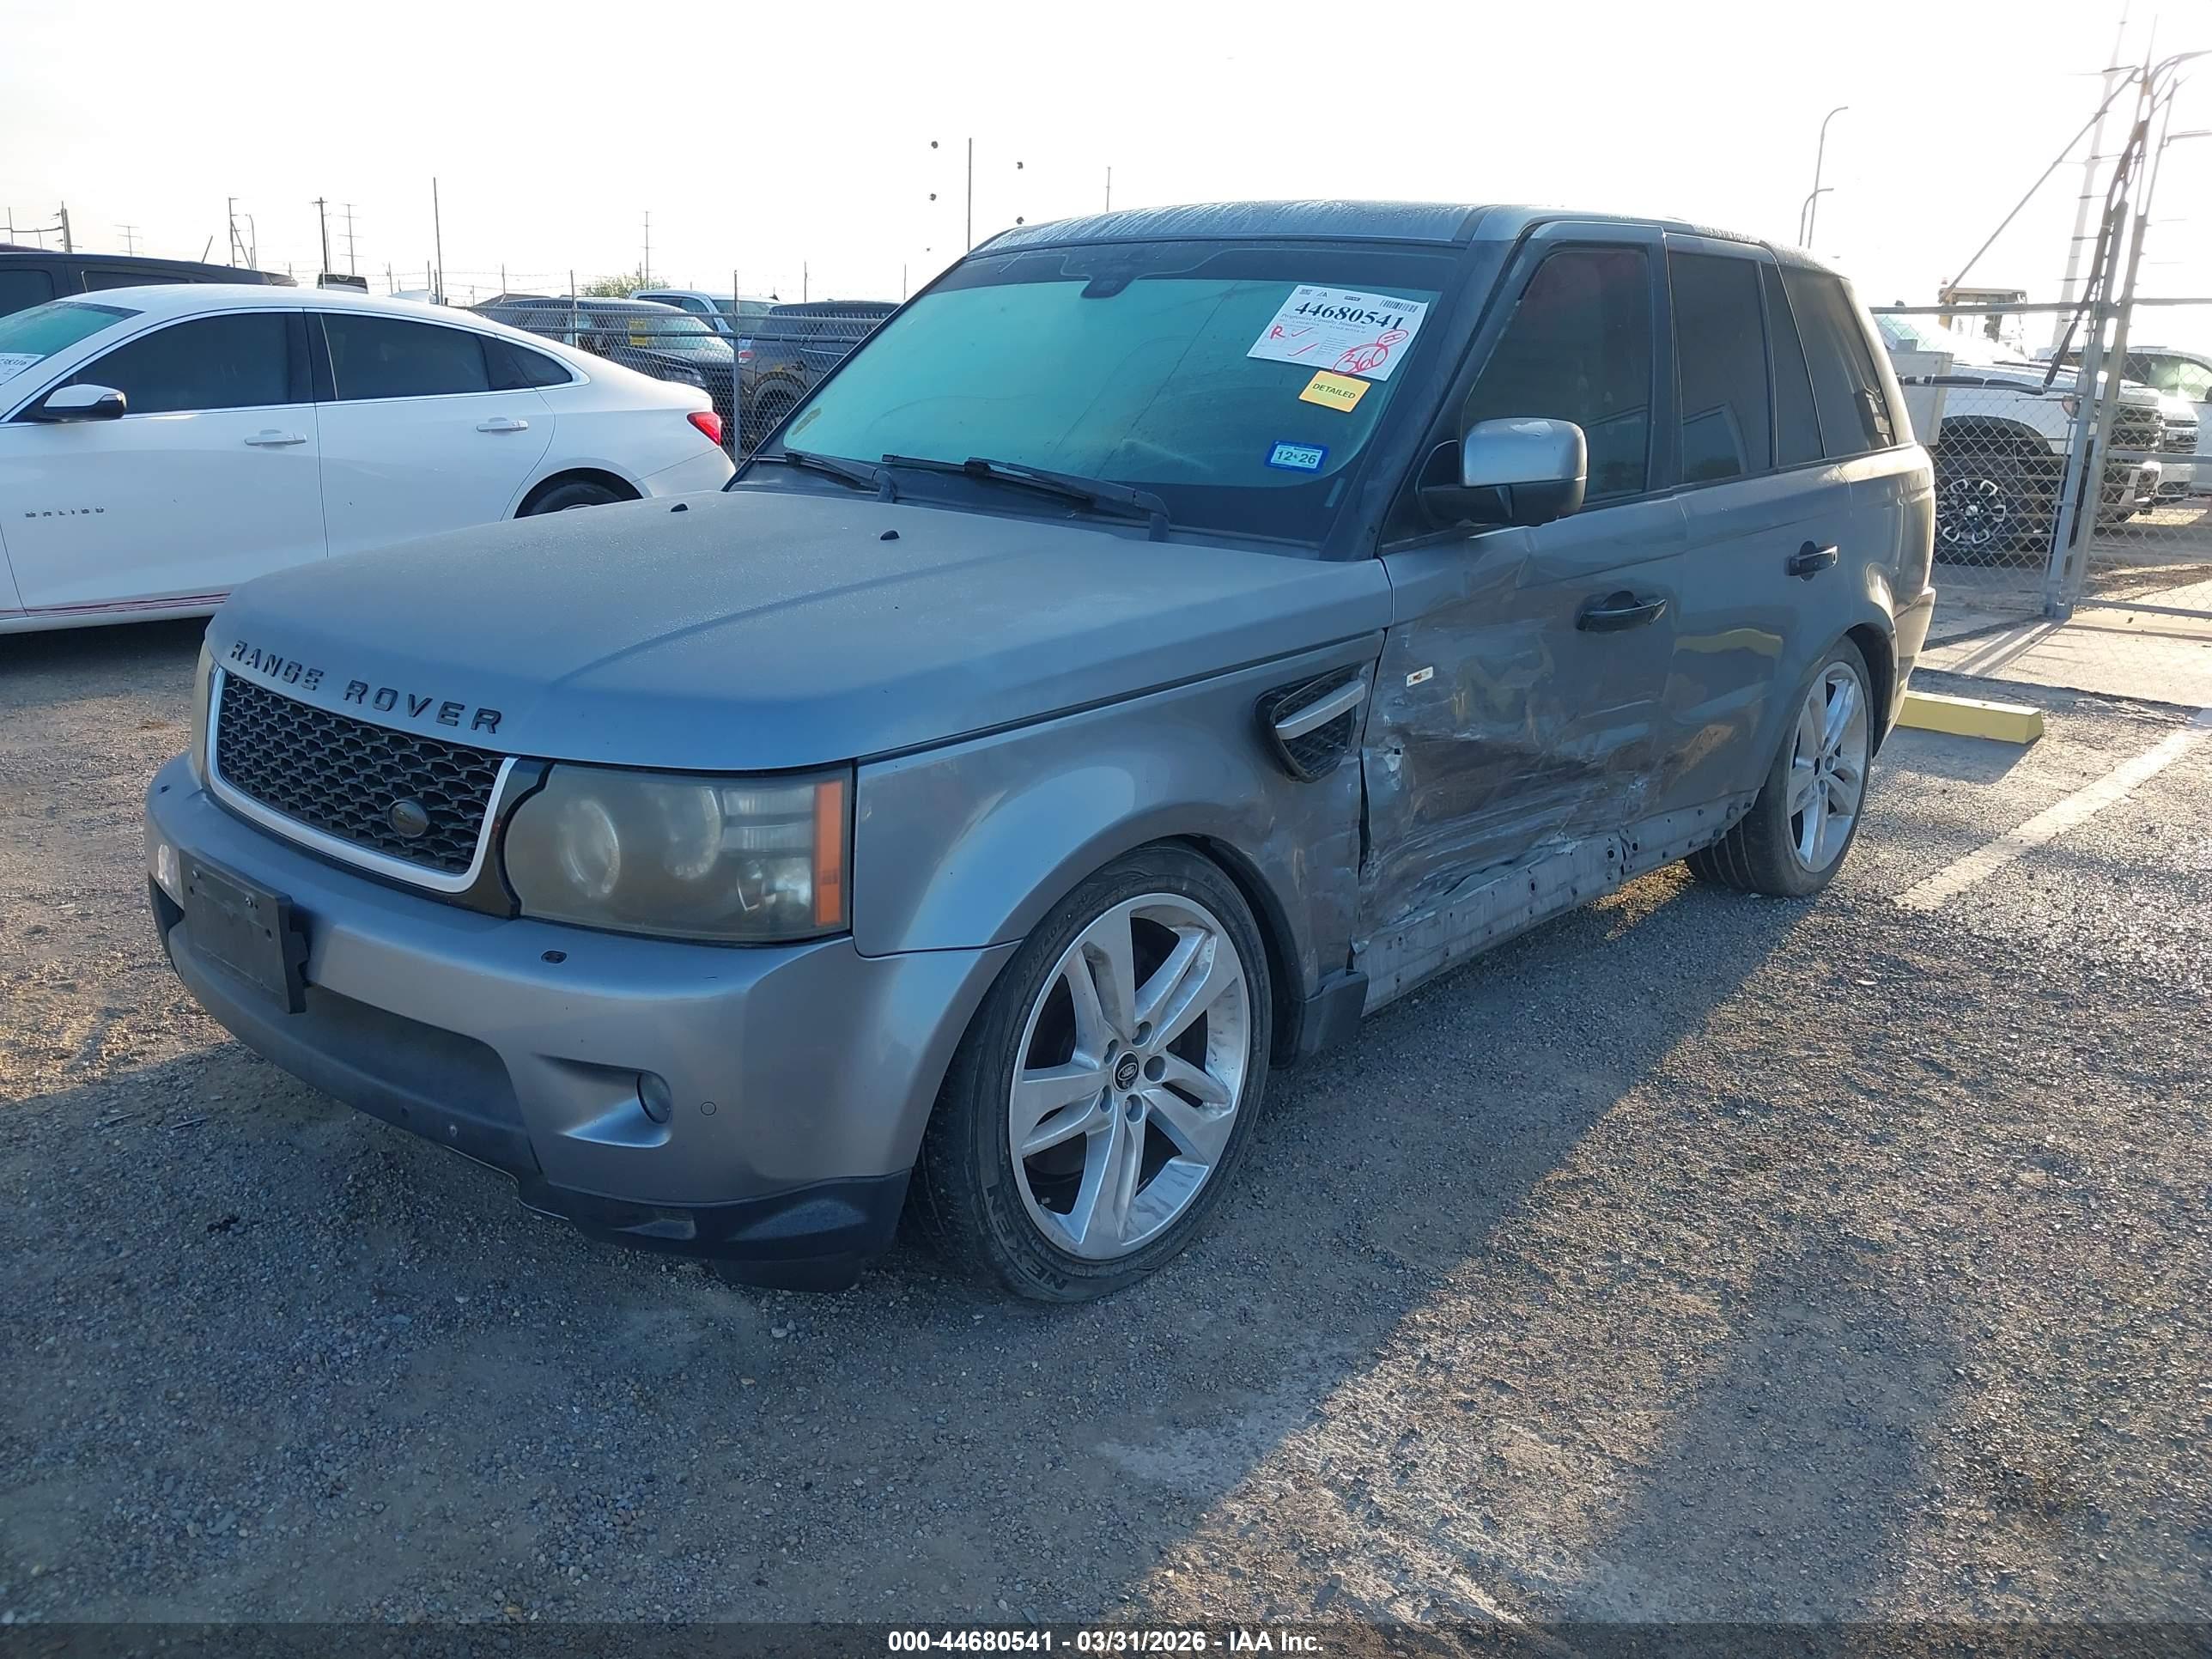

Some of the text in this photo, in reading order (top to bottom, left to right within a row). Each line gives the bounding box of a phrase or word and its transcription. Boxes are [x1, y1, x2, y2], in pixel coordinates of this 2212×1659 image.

[1294, 301, 1405, 331] 44680541
[1270, 325, 1285, 340] R
[1312, 383, 1356, 399] DETAILED
[1277, 450, 1293, 461] 12
[1297, 453, 1318, 465] 26
[25, 507, 105, 518] MALIBU
[230, 639, 502, 733] RANGE ROVER
